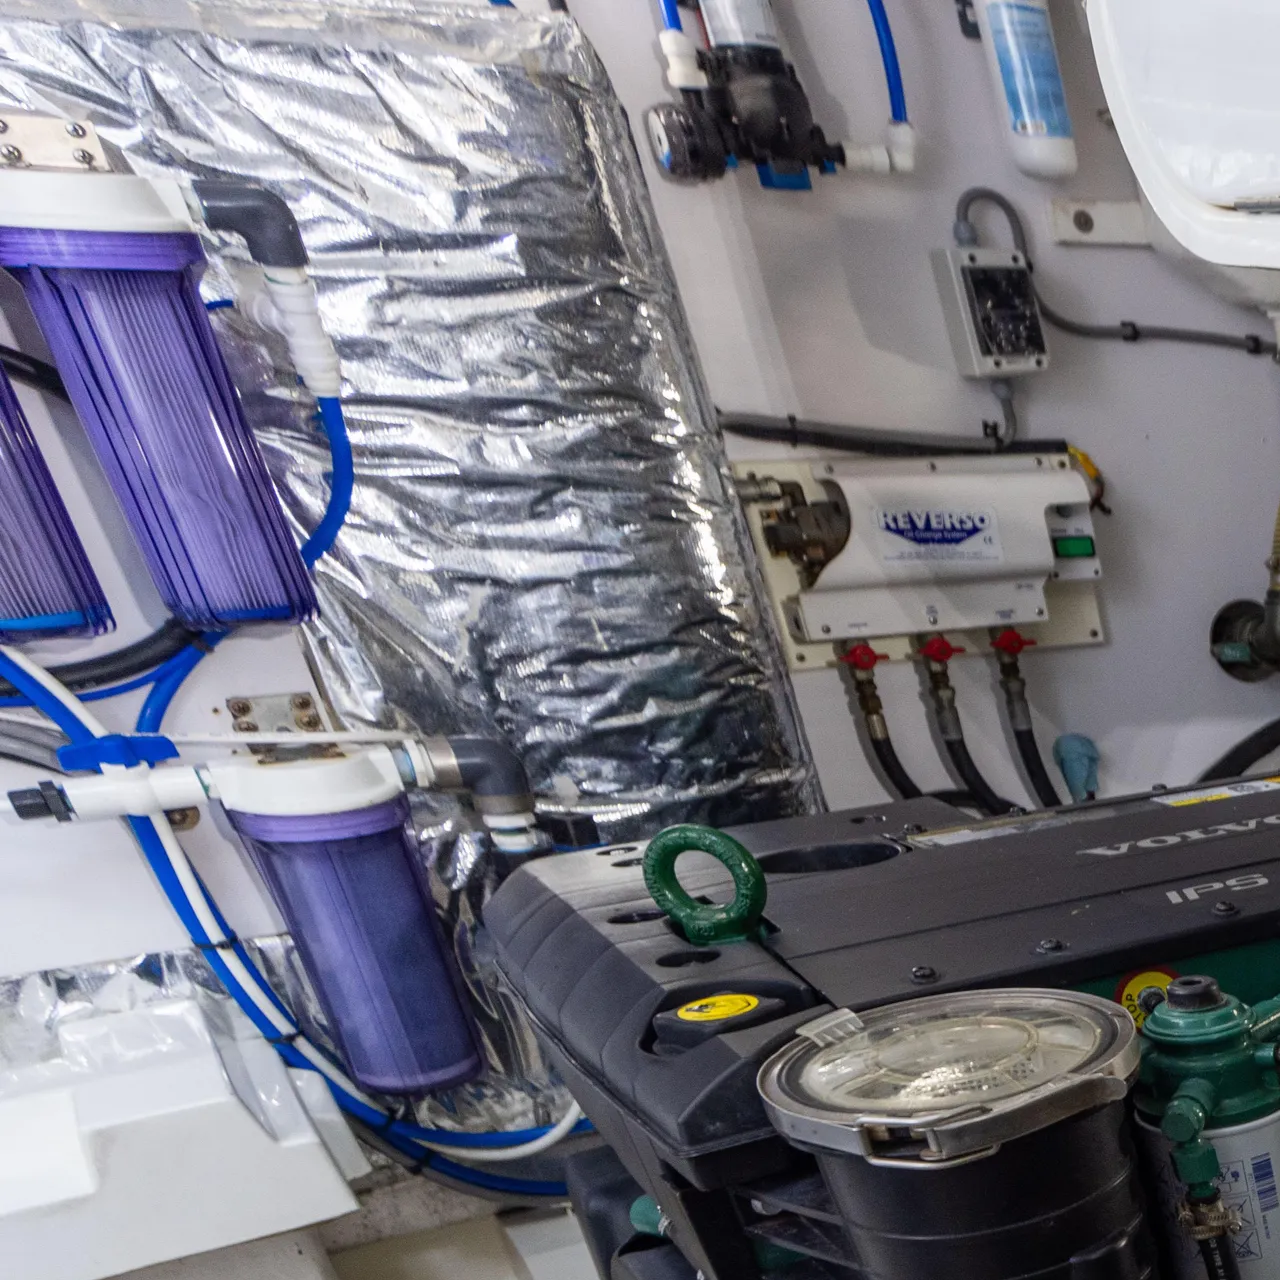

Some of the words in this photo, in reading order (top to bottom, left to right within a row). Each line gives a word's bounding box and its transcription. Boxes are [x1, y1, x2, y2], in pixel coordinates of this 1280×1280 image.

[878, 508, 991, 531] REVERSO
[944, 530, 968, 540] System
[1165, 872, 1269, 906] IPS
[1125, 993, 1145, 1023] TOP
